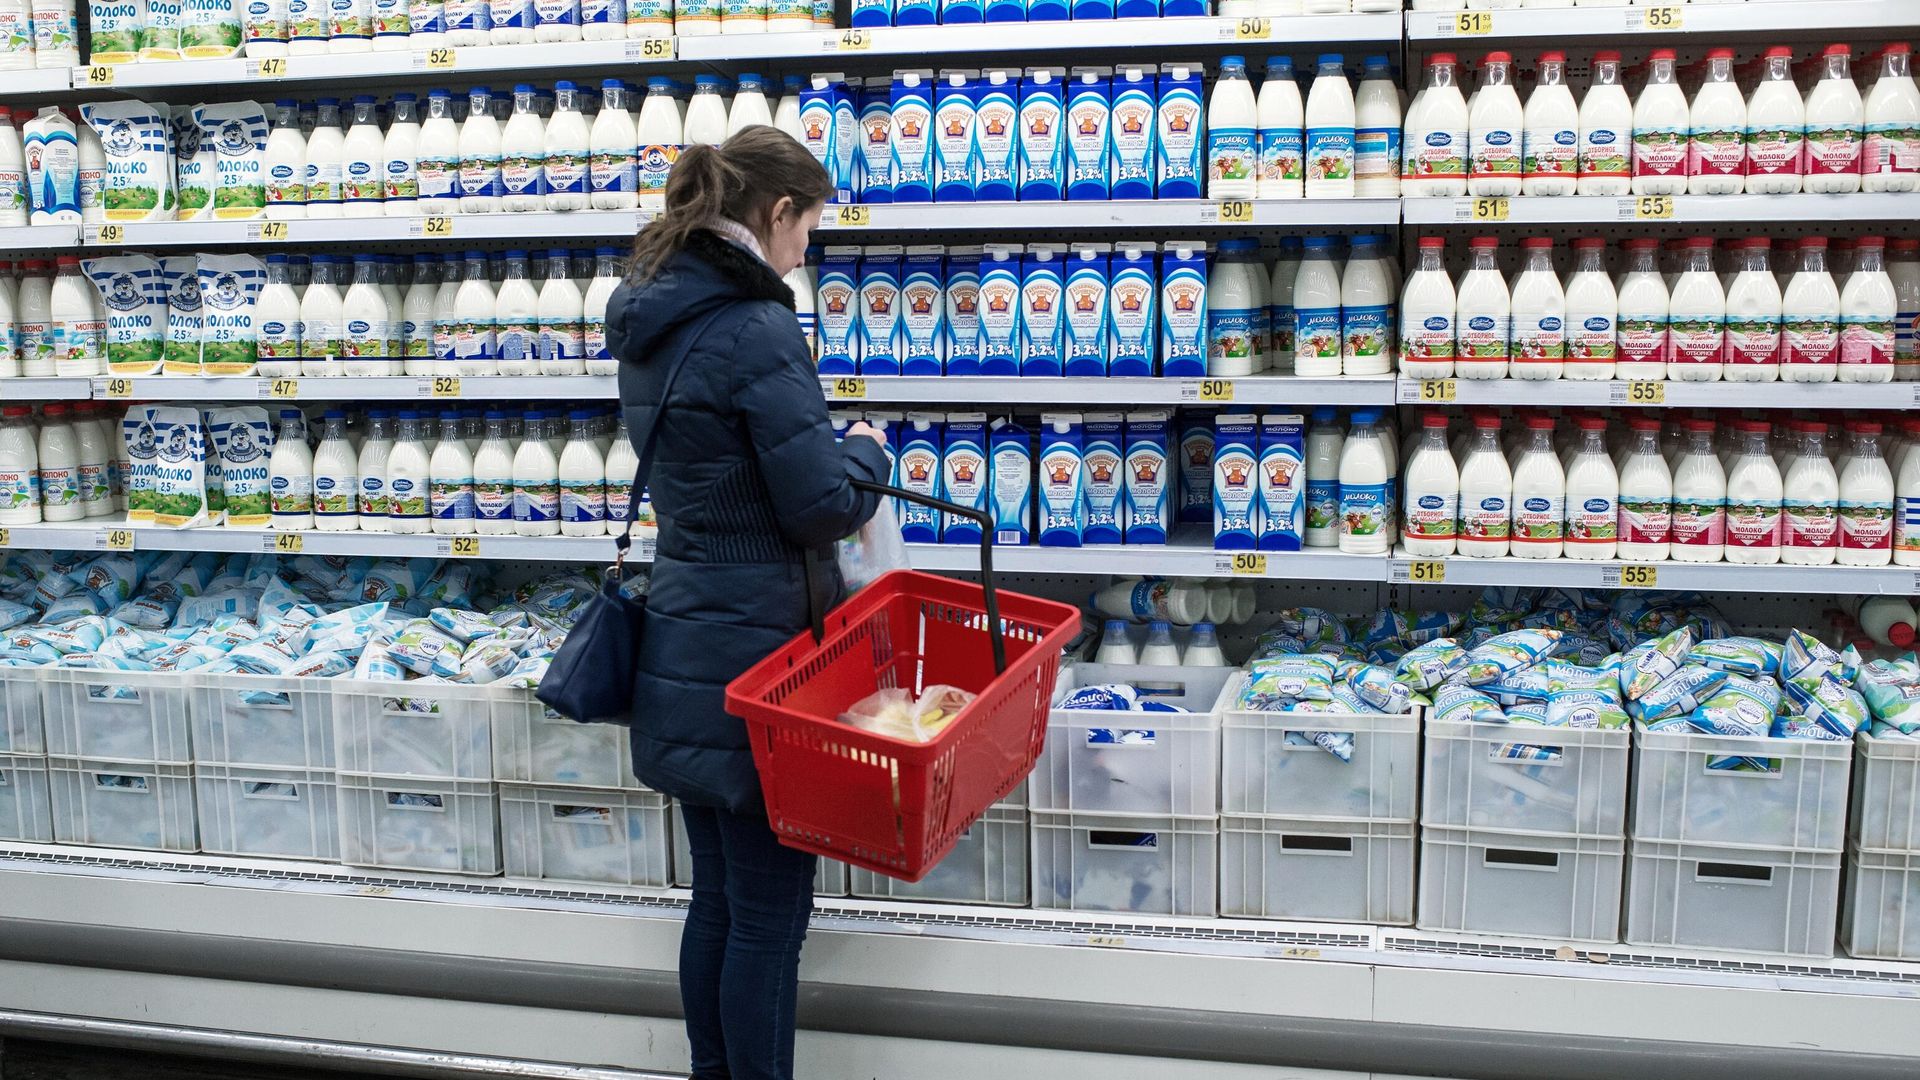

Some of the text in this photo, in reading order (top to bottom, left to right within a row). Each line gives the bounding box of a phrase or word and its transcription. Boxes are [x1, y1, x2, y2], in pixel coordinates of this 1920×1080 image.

[1460, 14, 1480, 31] 51
[1649, 8, 1671, 24] 55
[644, 40, 662, 55] 55
[430, 49, 447, 64] 52
[263, 58, 278, 74] 47
[90, 68, 106, 82] 49
[900, 170, 925, 182] 3,2%
[943, 170, 968, 182] 3,2%
[983, 168, 1008, 181] 3,2%
[1027, 168, 1053, 181] 3,2%
[1075, 167, 1101, 180] 3,2%
[1120, 167, 1145, 179] 3,2%
[1166, 166, 1193, 178] 3,2%
[113, 175, 131, 187] 2,5%
[224, 174, 243, 185] 2,5%
[1223, 202, 1242, 217] 50
[1478, 201, 1498, 217] 51
[1641, 198, 1663, 214] 55
[841, 207, 860, 221] 45
[264, 223, 280, 237] 47
[427, 218, 444, 231] 52
[101, 226, 116, 240] 49
[119, 331, 137, 340] 2,5%
[174, 330, 191, 339] 2,5%
[216, 330, 235, 340] 2,5%
[824, 344, 848, 356] 3,2%
[867, 344, 893, 356] 3,2%
[909, 344, 935, 356] 3,2%
[954, 344, 979, 356] 3,2%
[987, 344, 1012, 355] 3,2%
[1029, 344, 1055, 356] 3,2%
[1073, 344, 1099, 356] 3,2%
[1117, 344, 1144, 356] 3,2%
[1171, 344, 1198, 356] 3,2%
[110, 380, 124, 394] 49
[275, 381, 291, 394] 47
[435, 378, 452, 392] 52
[838, 379, 856, 392] 45
[1202, 381, 1222, 395] 50
[1425, 382, 1444, 398] 51
[1633, 384, 1655, 399] 55
[135, 479, 151, 488] 2,5%
[161, 483, 176, 492] 2,5%
[235, 484, 253, 493] 2,5%
[906, 512, 931, 524] 3,2%
[1048, 515, 1074, 528] 3,2%
[1089, 513, 1114, 525] 3,2%
[1133, 514, 1159, 525] 3,2%
[1222, 518, 1250, 530] 3,2%
[1266, 519, 1294, 531] 3,2%
[110, 531, 126, 544] 49
[279, 535, 294, 549] 47
[455, 538, 471, 551] 52
[1237, 554, 1255, 568] 50
[1415, 563, 1434, 579] 51
[1626, 567, 1647, 582] 55
